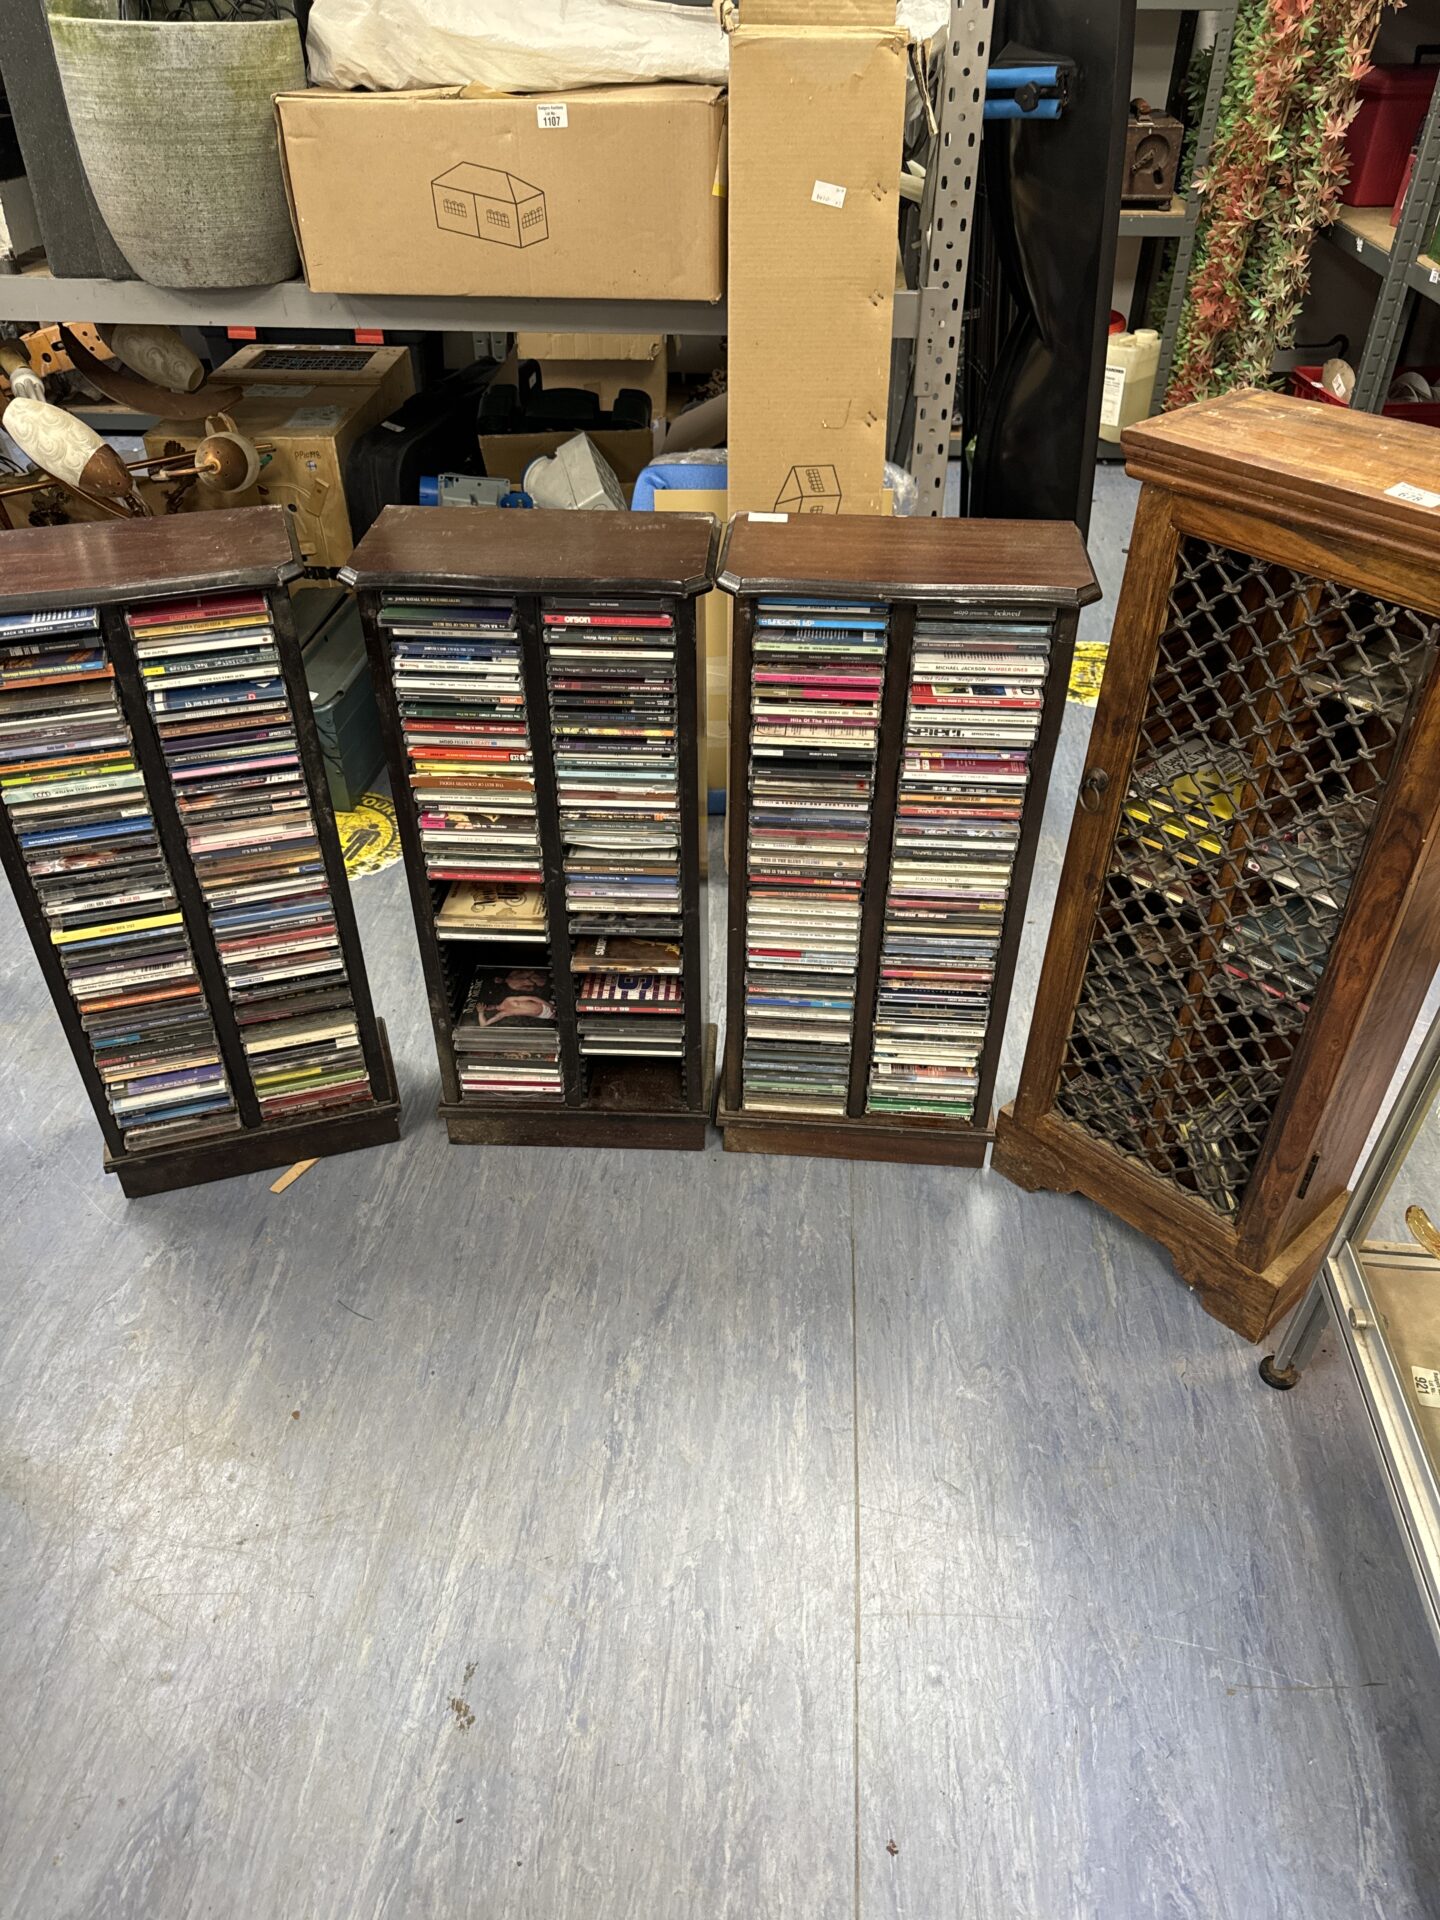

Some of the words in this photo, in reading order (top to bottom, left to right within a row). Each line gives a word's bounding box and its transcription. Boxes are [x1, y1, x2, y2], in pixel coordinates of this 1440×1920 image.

[543, 117, 560, 126] 1107
[564, 616, 591, 624] orson
[264, 771, 299, 783] UNCUT
[1414, 1376, 1431, 1395] 921
